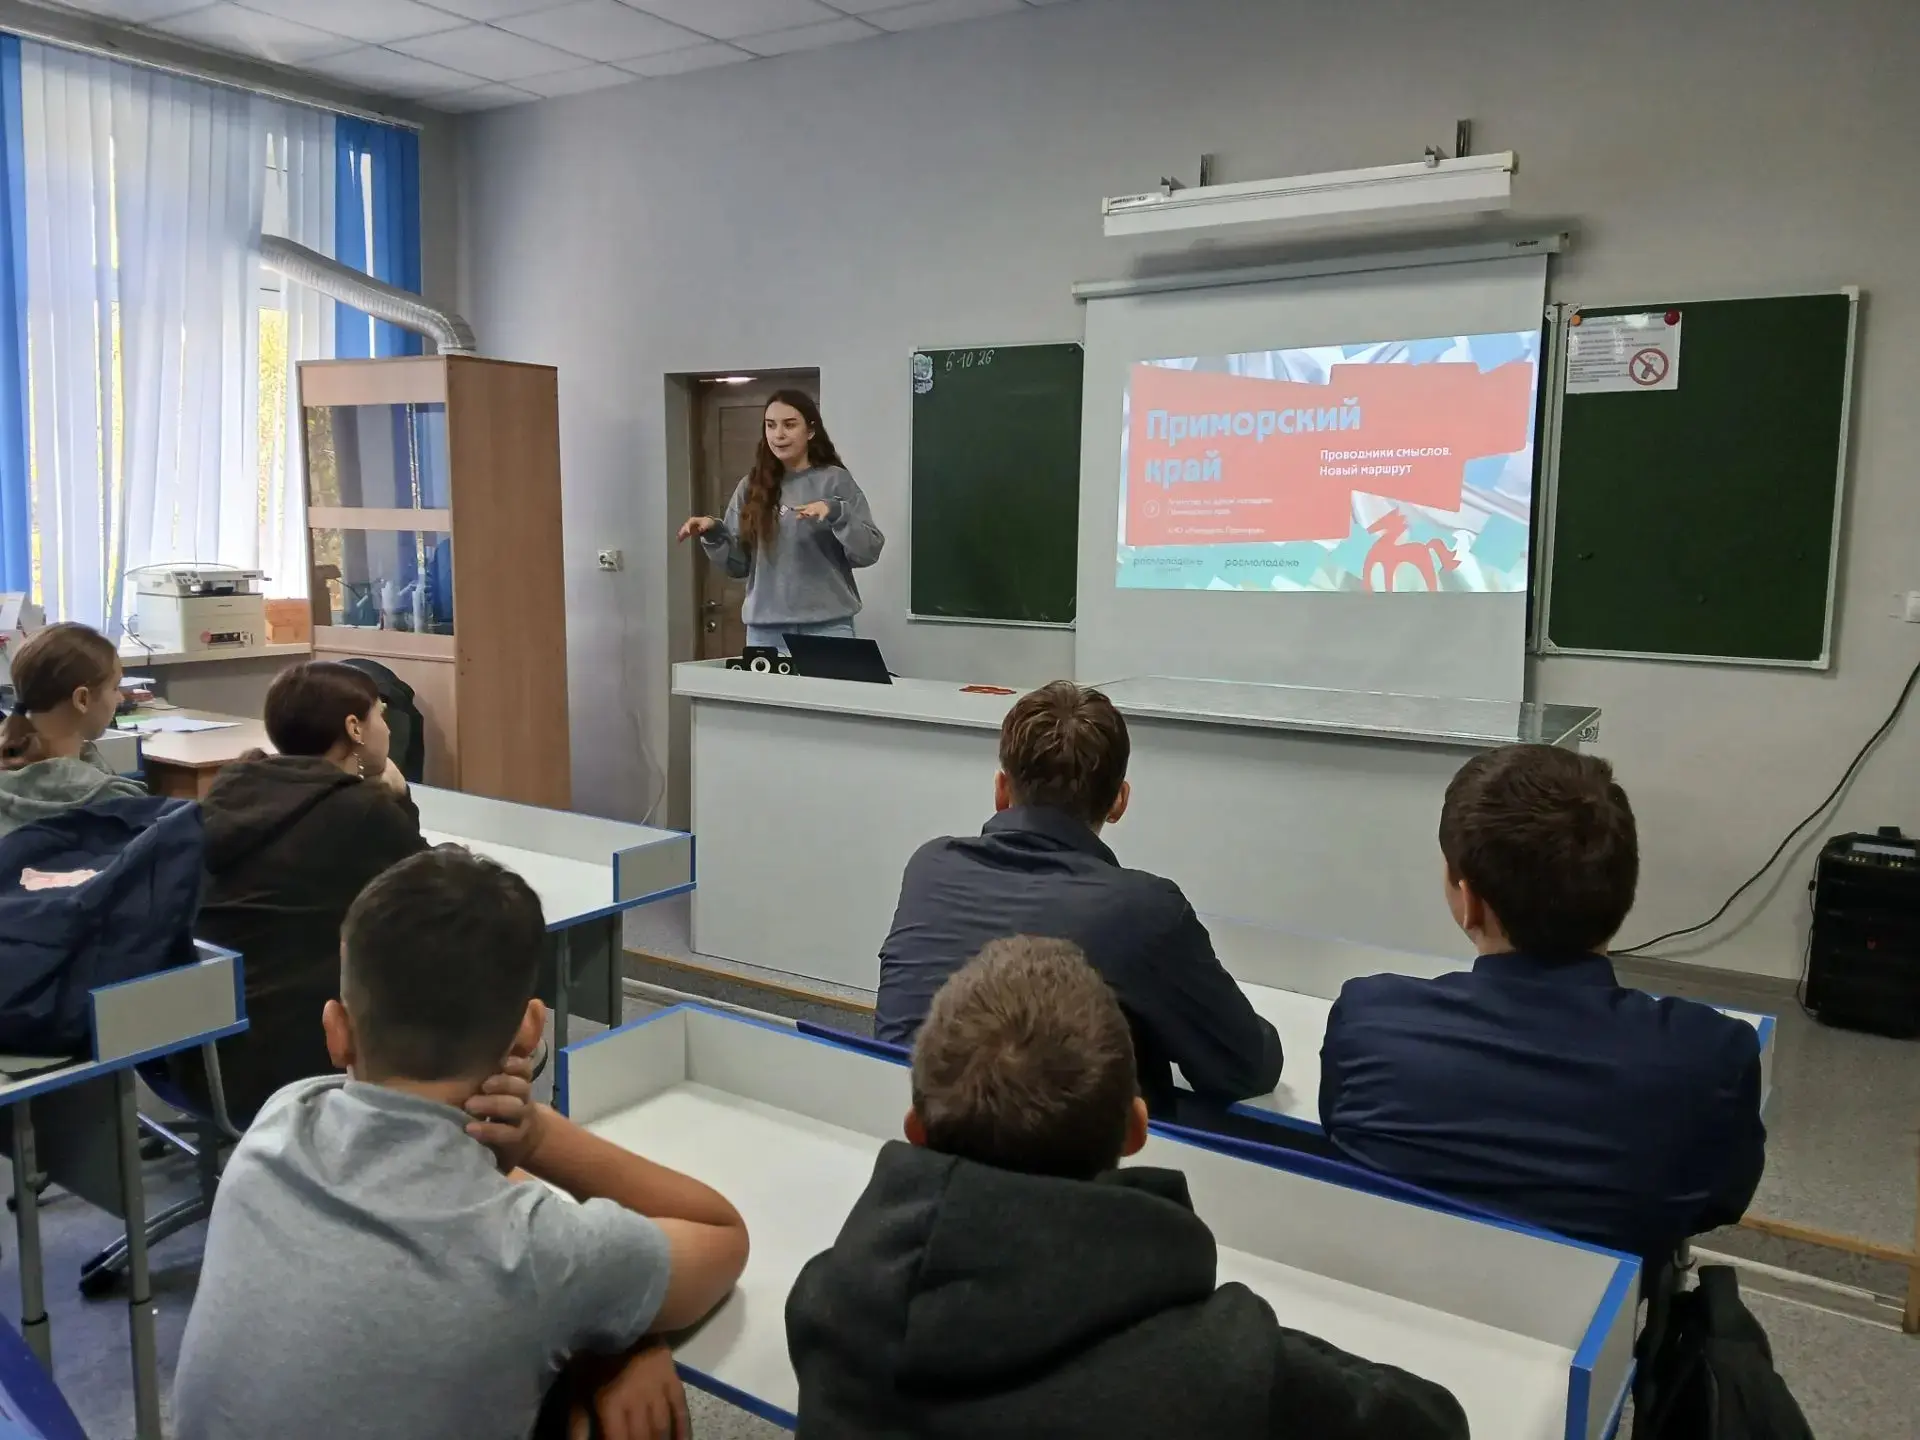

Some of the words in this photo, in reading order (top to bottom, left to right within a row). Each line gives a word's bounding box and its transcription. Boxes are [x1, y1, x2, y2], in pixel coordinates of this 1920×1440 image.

[1146, 397, 1361, 446] Приморский
[1320, 449, 1394, 462] Проводники
[1396, 446, 1452, 458] смыслов.
[1145, 450, 1222, 489] край
[1319, 465, 1359, 477] Новый
[1361, 463, 1412, 478] маршрут
